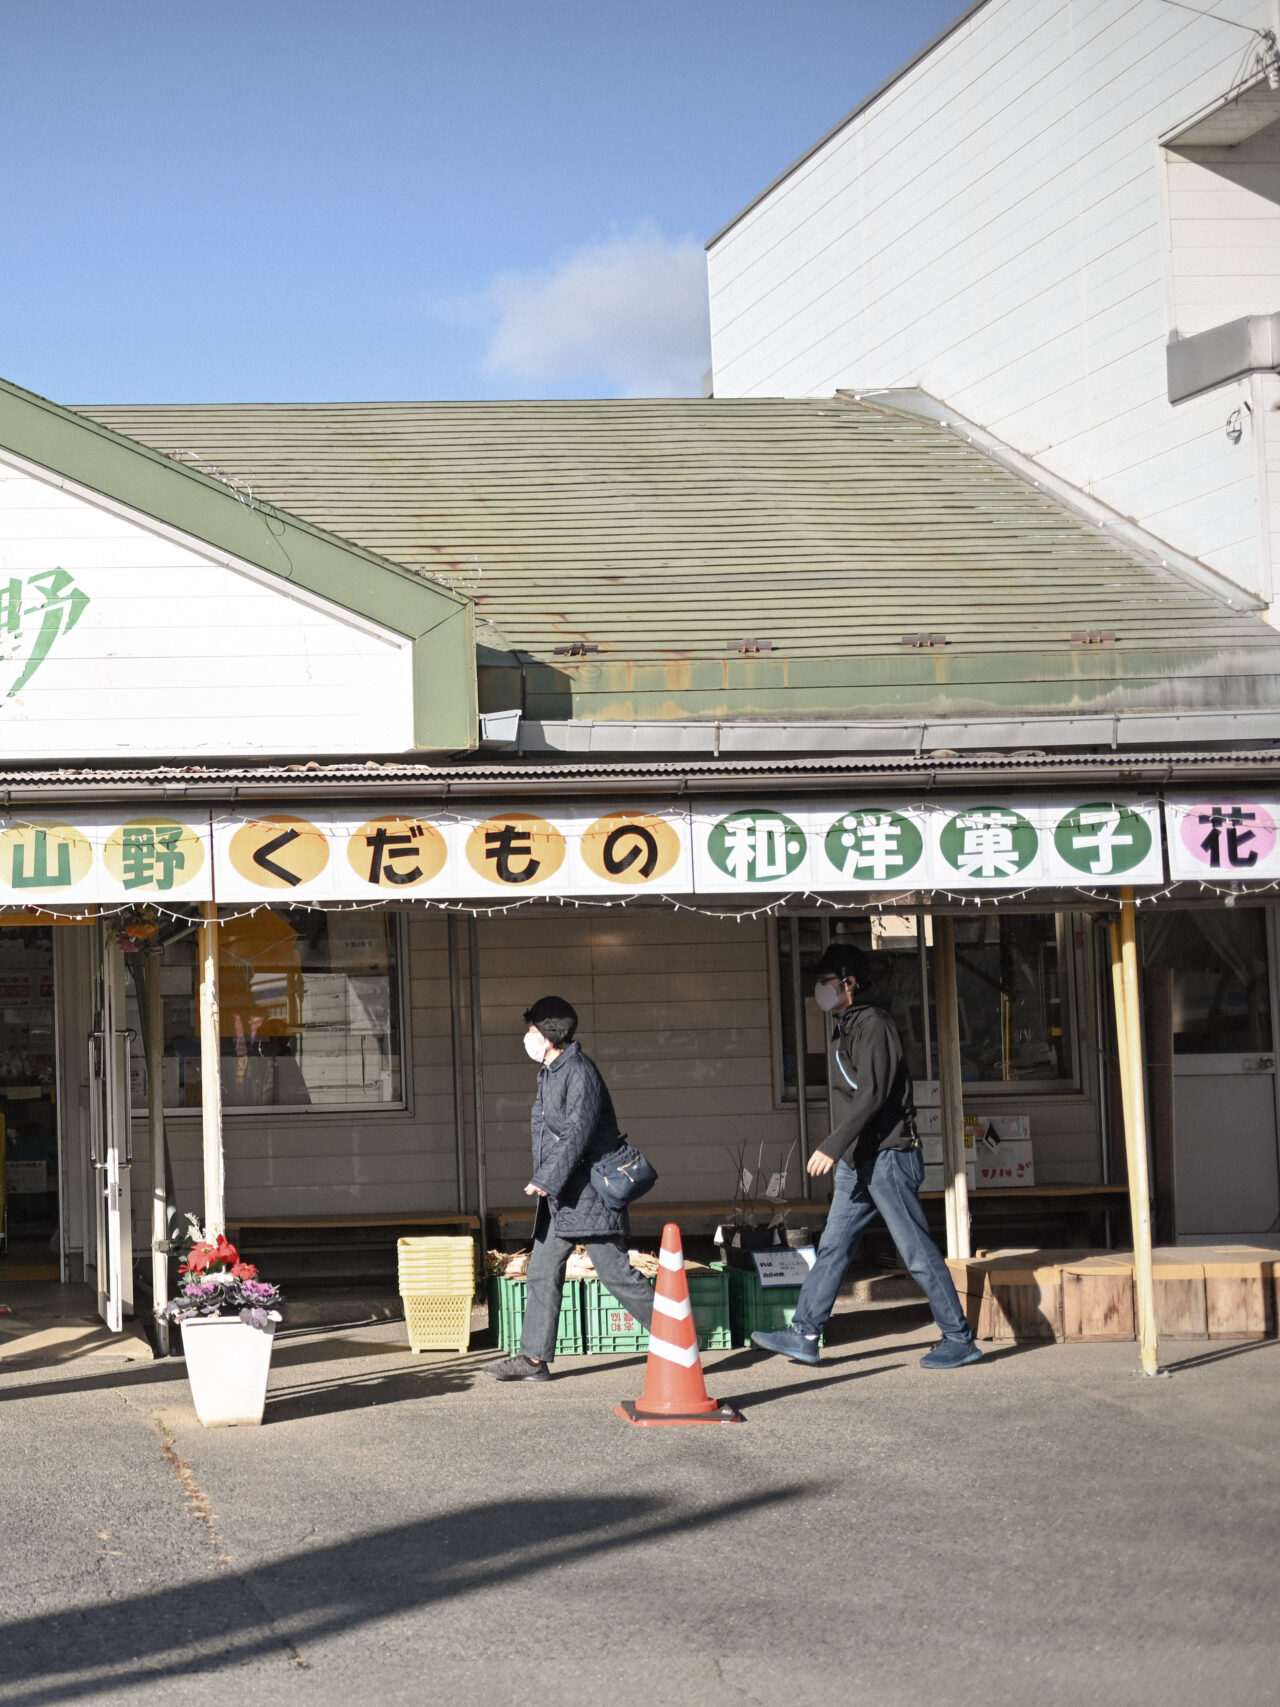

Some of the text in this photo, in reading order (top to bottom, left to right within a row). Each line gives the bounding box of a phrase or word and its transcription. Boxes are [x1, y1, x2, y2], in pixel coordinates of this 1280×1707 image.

[252, 823, 659, 888] くだもの
[1199, 806, 1259, 870] 花
